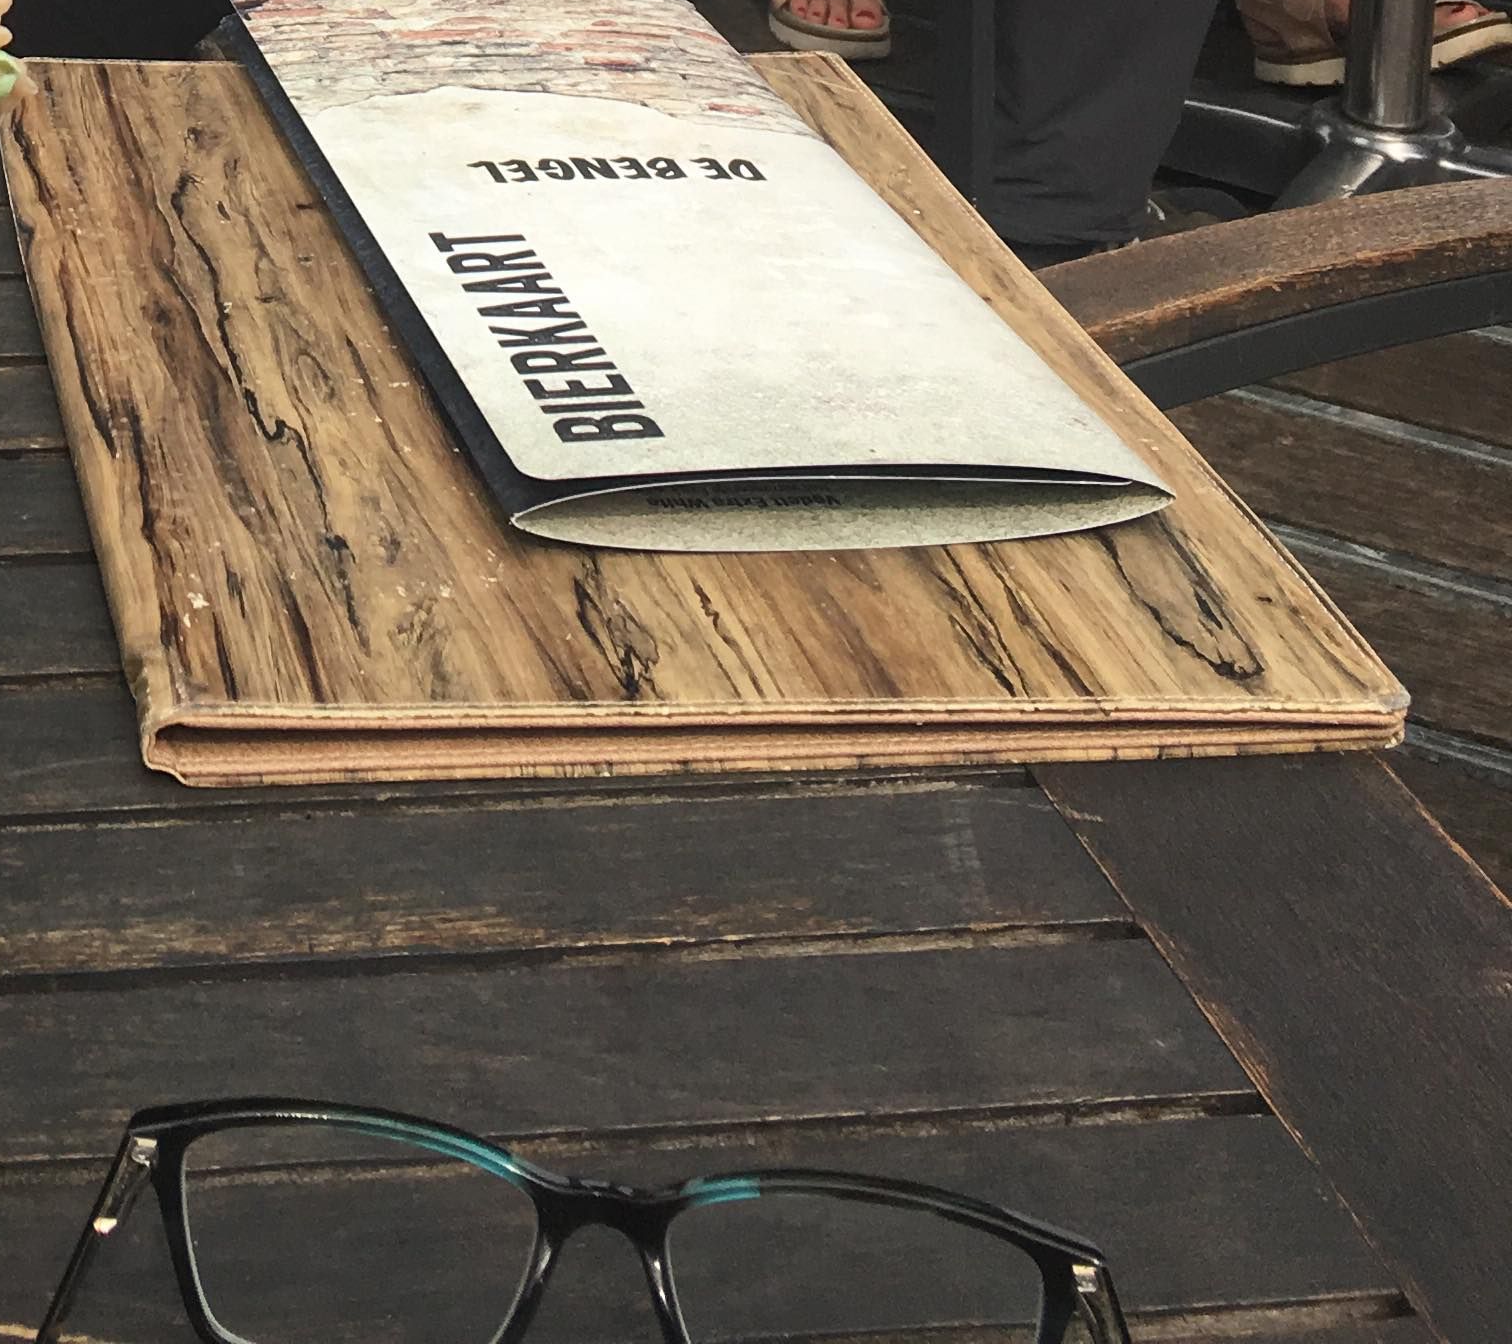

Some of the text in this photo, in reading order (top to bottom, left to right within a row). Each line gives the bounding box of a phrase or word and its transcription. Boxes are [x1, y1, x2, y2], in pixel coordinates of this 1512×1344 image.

[467, 157, 767, 183] DE BENGEL
[428, 232, 665, 443] BIERKAART
